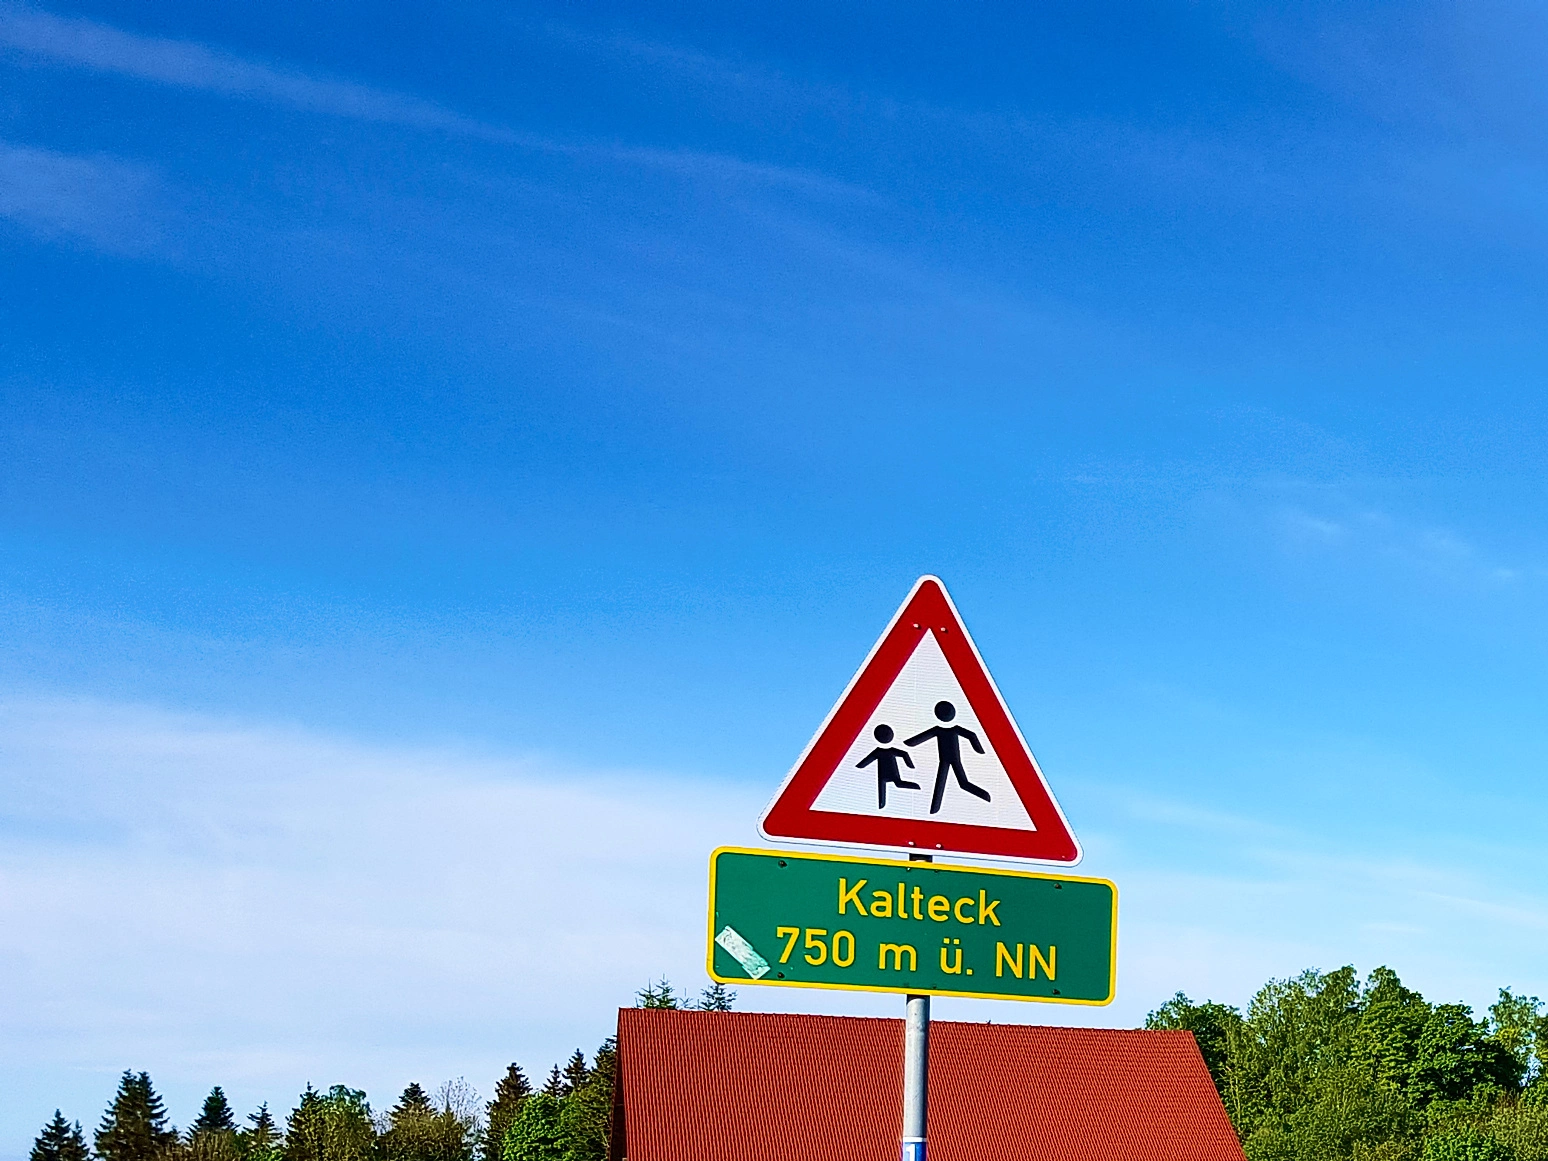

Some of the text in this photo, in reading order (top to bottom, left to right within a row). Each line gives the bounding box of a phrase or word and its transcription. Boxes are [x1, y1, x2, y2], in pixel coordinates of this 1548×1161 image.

[838, 878, 1001, 926] Kalteck
[777, 927, 855, 968] 750
[878, 943, 917, 971] m
[940, 938, 973, 975] ü.
[996, 941, 1056, 981] NN
